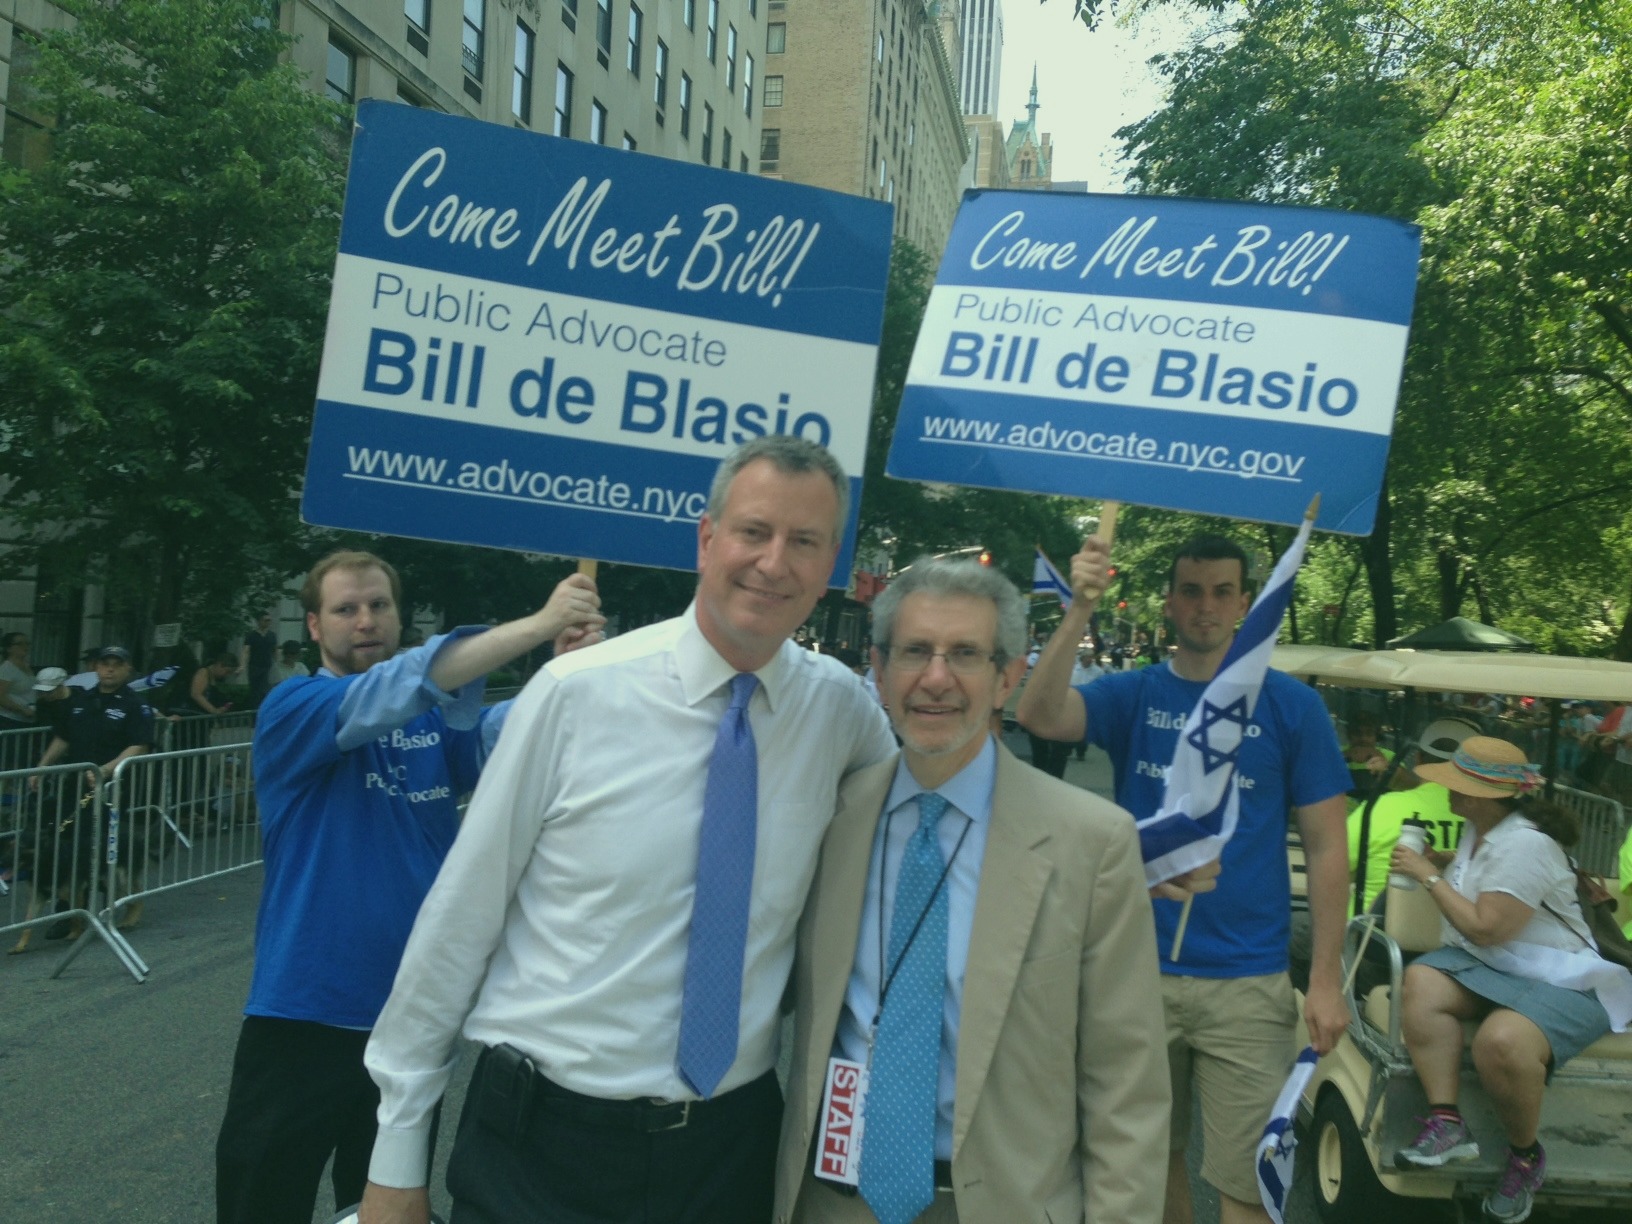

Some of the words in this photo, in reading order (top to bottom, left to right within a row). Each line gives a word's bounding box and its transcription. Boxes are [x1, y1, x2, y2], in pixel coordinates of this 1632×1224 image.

[383, 147, 520, 249] Come
[527, 176, 682, 277] Meet
[677, 203, 821, 308] Bill!
[970, 210, 1078, 272] Come
[1080, 216, 1218, 280] Meet
[1211, 225, 1350, 296] Bill!
[373, 272, 511, 333] Public
[526, 302, 727, 367] Advocate
[953, 294, 1062, 328] Public
[1074, 302, 1255, 344] Advocate
[362, 327, 487, 409] Bill
[509, 357, 595, 425] de
[620, 370, 831, 447] Blasio
[940, 331, 1038, 384] Bill
[1056, 343, 1130, 393] de
[1151, 349, 1358, 416] Blasio
[347, 445, 706, 523] www.advocate.nyc
[924, 415, 1305, 480] www.advocate.nyc.gov
[824, 1067, 858, 1175] STAFF
